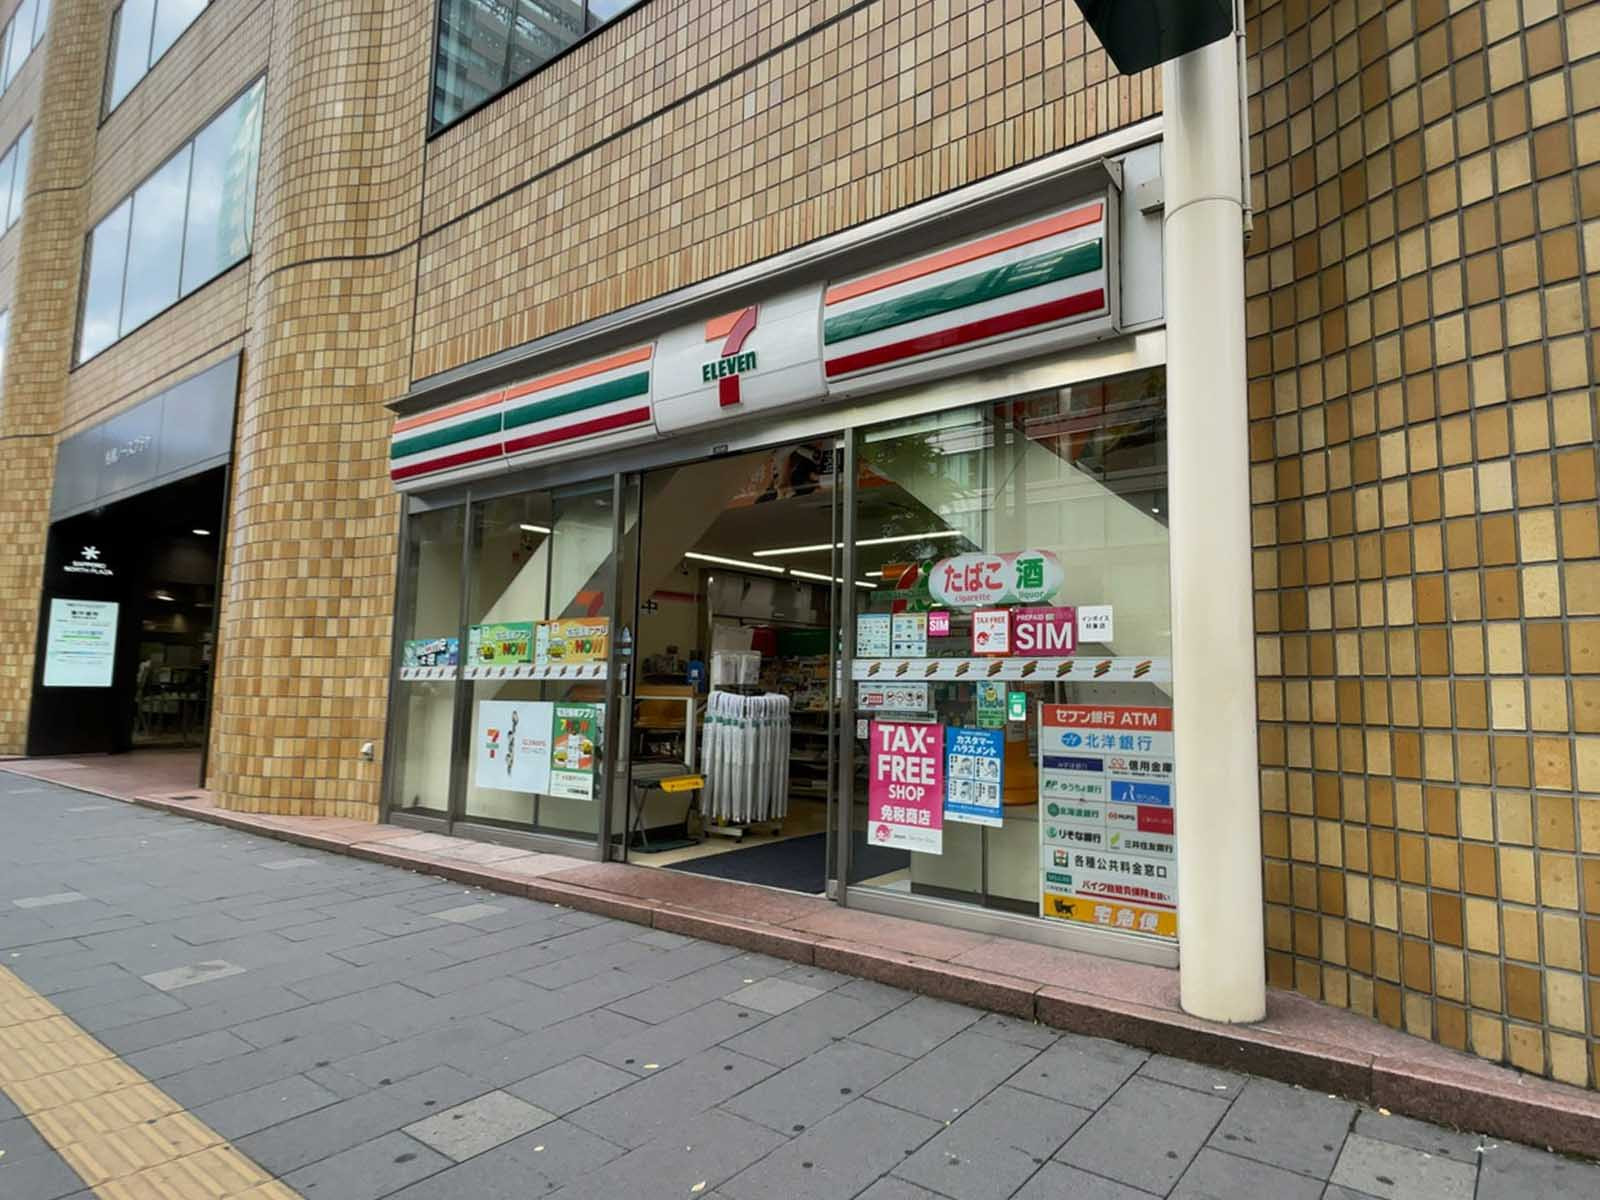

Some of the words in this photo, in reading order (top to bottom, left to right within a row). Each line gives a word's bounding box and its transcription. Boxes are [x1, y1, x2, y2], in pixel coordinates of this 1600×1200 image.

[944, 563, 1004, 593] たばこ
[1016, 558, 1044, 589] 酒
[929, 620, 949, 632] SIM
[1016, 622, 1073, 650] SIM
[1056, 709, 1115, 725] セブン銀行
[1120, 712, 1158, 726] ATM
[878, 724, 936, 754] TAX-
[956, 735, 995, 745] カスタマー
[1085, 733, 1153, 751] 北洋銀行
[877, 754, 936, 785] FREE
[1129, 760, 1173, 772] 信用金庫
[888, 784, 925, 801] SHOP
[1061, 783, 1102, 793] ゆうちょ銀行
[1060, 807, 1100, 818] 北海道銀行
[1059, 829, 1102, 843] りそな銀行
[1124, 840, 1174, 853] 三井住友銀行
[1075, 854, 1168, 878] 各種公共料金窓口
